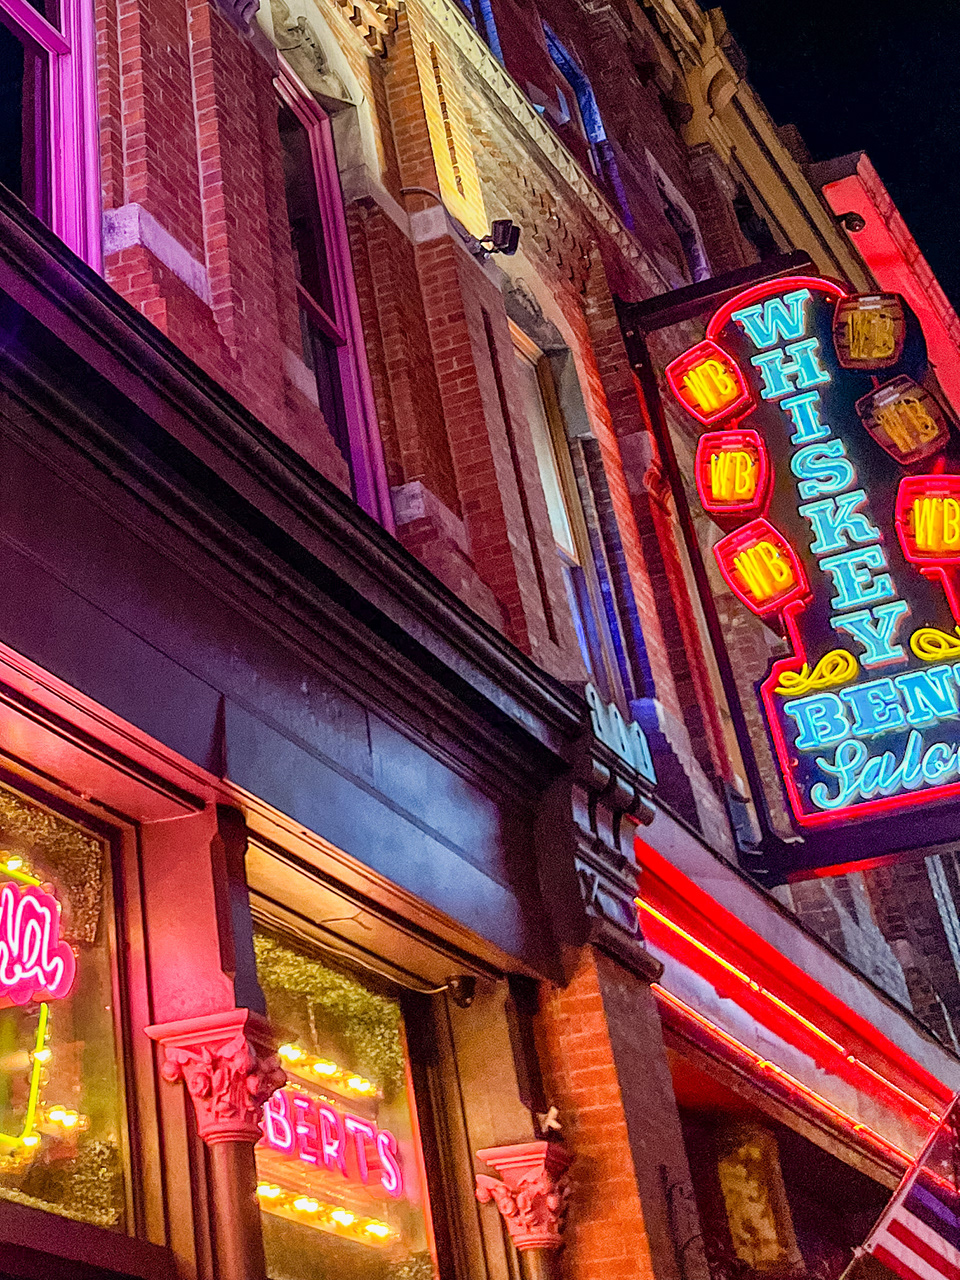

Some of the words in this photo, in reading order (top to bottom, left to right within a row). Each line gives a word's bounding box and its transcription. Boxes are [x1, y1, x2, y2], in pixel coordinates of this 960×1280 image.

[682, 358, 736, 414] WB
[710, 451, 756, 501] WB
[730, 287, 910, 670] WHISKEY
[914, 497, 960, 547] WB
[734, 540, 790, 602] WB
[783, 663, 960, 751] BEN
[811, 729, 960, 810] Salo
